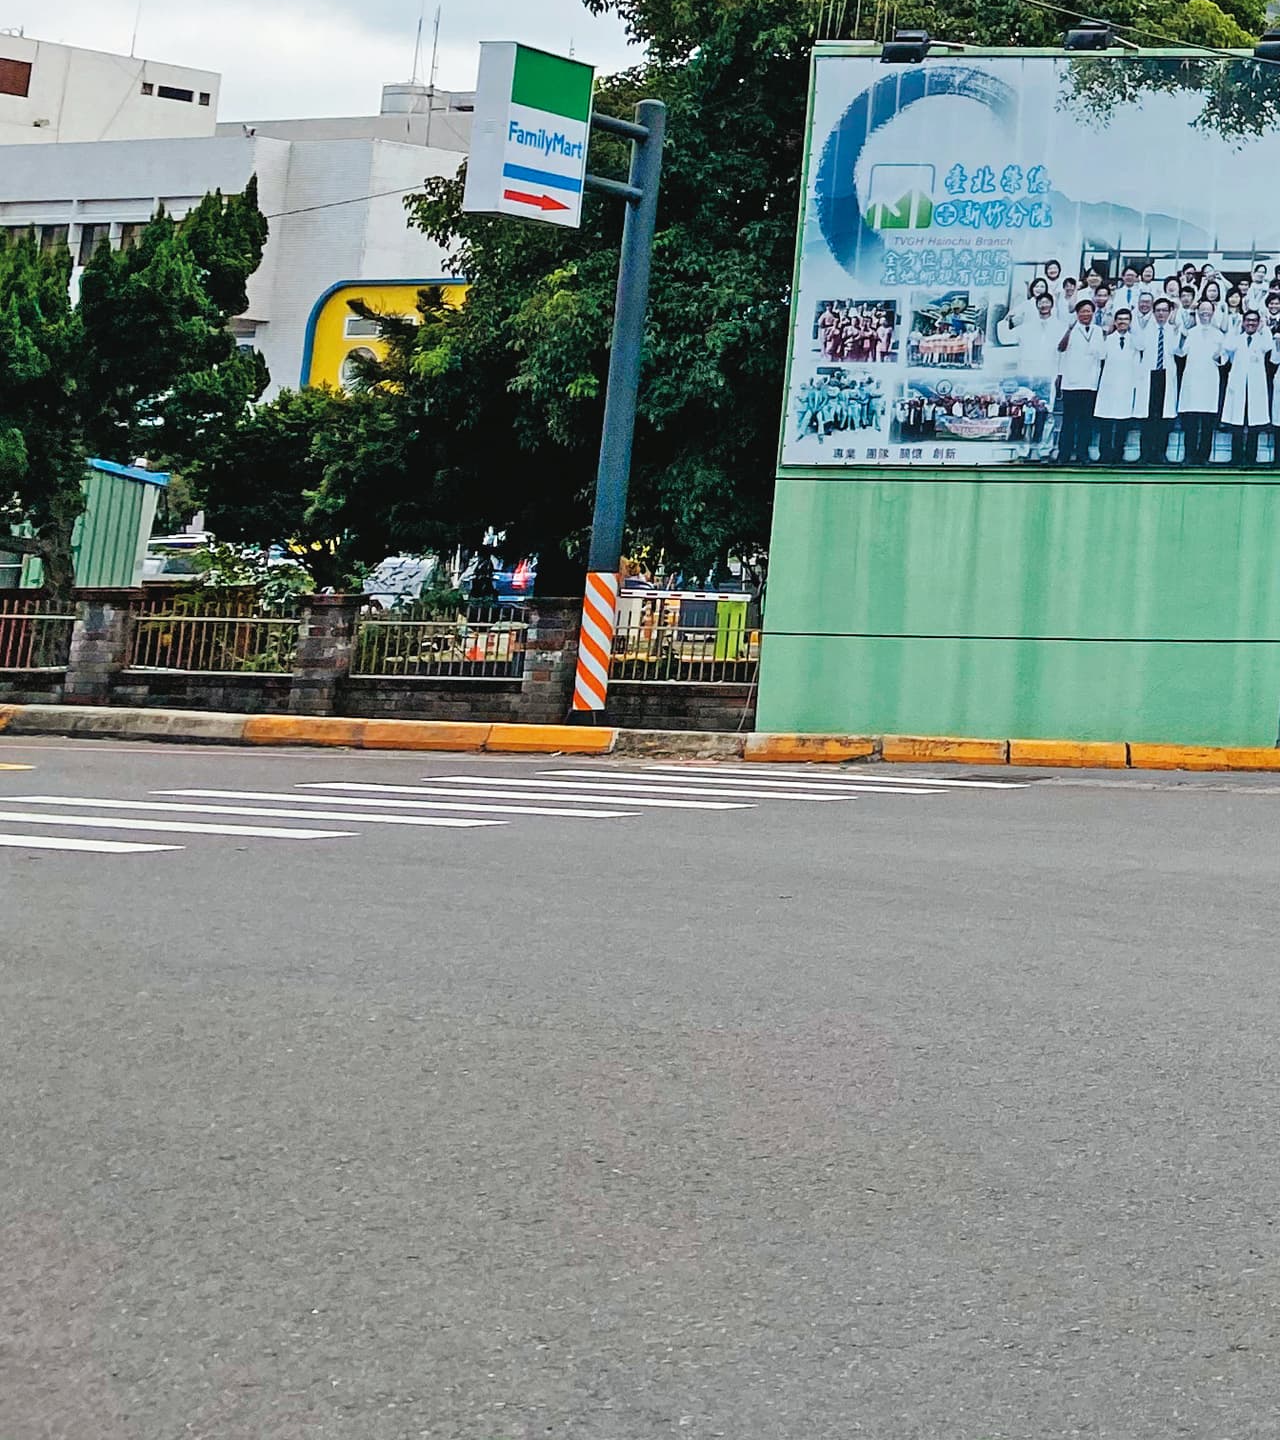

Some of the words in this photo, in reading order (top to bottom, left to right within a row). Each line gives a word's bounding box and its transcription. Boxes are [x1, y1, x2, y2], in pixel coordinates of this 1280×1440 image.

[508, 120, 583, 159] FamilyMart
[959, 199, 1052, 228] 新竹分院
[894, 236, 925, 246] TVGH
[928, 236, 971, 246] Hsinchu
[975, 236, 1013, 246] Branch
